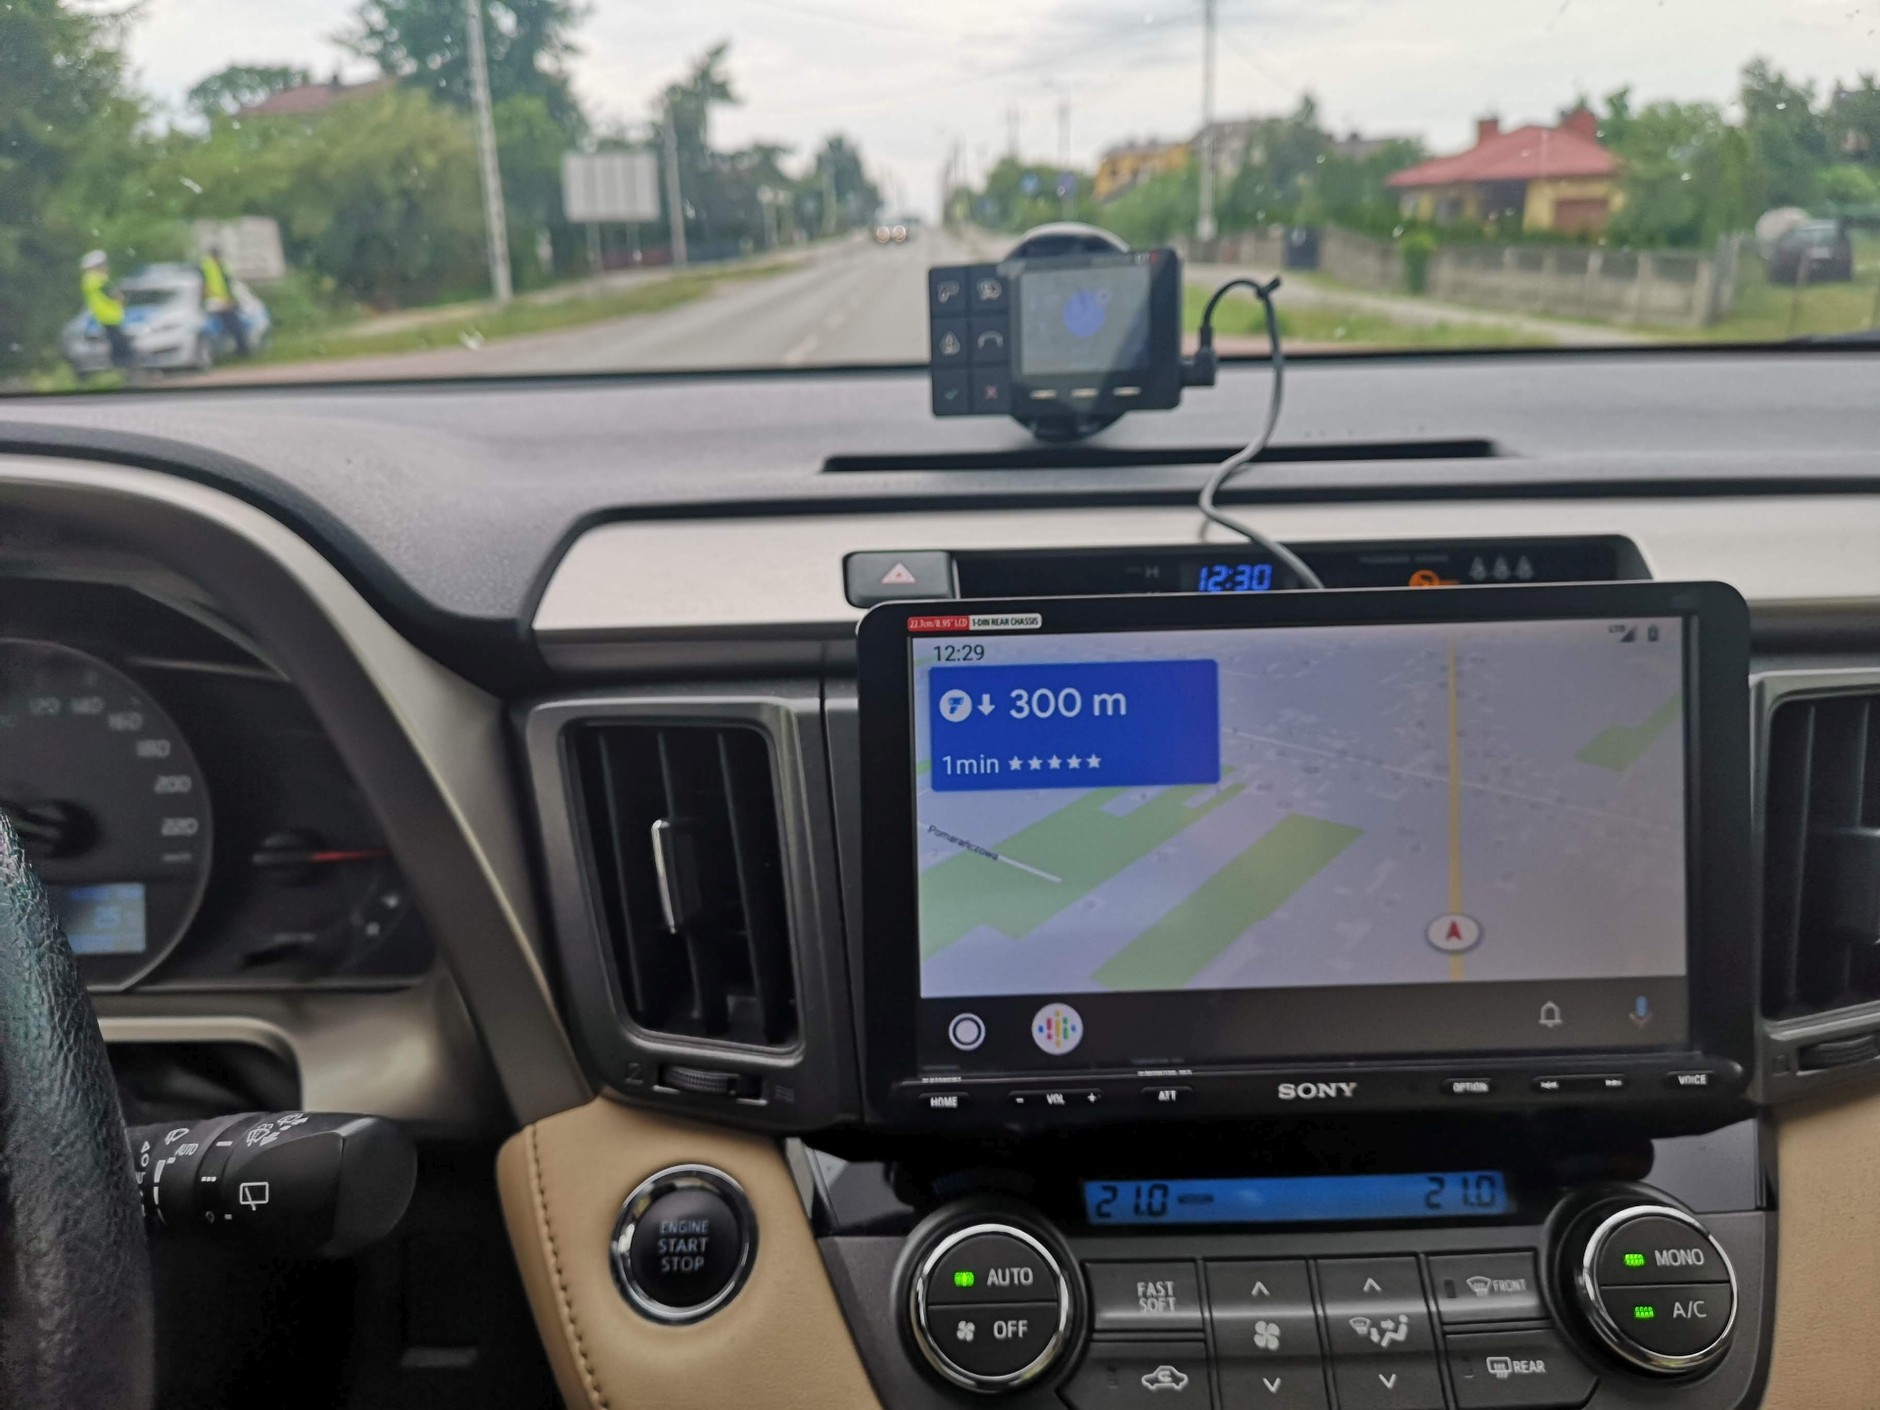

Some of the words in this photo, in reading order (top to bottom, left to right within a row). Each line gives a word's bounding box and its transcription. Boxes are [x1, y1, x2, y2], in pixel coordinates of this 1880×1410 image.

[1199, 564, 1272, 591] 12:30
[955, 617, 968, 627] LCD
[991, 615, 1010, 626] REAR
[1011, 614, 1039, 626] CHASSIS
[934, 644, 985, 662] 12:29
[1009, 688, 1082, 719] 300
[1093, 692, 1127, 716] m
[942, 754, 1000, 775] 1min
[154, 774, 193, 794] 200
[1678, 1074, 1707, 1085] VOICE
[1158, 1090, 1176, 1101] ATT
[1277, 1082, 1358, 1100] SONY
[930, 1096, 958, 1108] HOME
[1046, 1093, 1066, 1105] VOL
[174, 1143, 199, 1156] AUTO
[660, 1220, 709, 1233] ENGINE
[658, 1238, 709, 1253] START
[661, 1257, 705, 1272] STOP
[1655, 1248, 1705, 1266] MONO
[986, 1267, 1034, 1287] AUTO
[1136, 1281, 1174, 1297] FAST
[1492, 1278, 1528, 1292] FRONT
[1139, 1298, 1176, 1313] SOFT
[1672, 1300, 1708, 1319] A/C
[993, 1320, 1029, 1339] OFF
[1512, 1360, 1546, 1374] REAR
